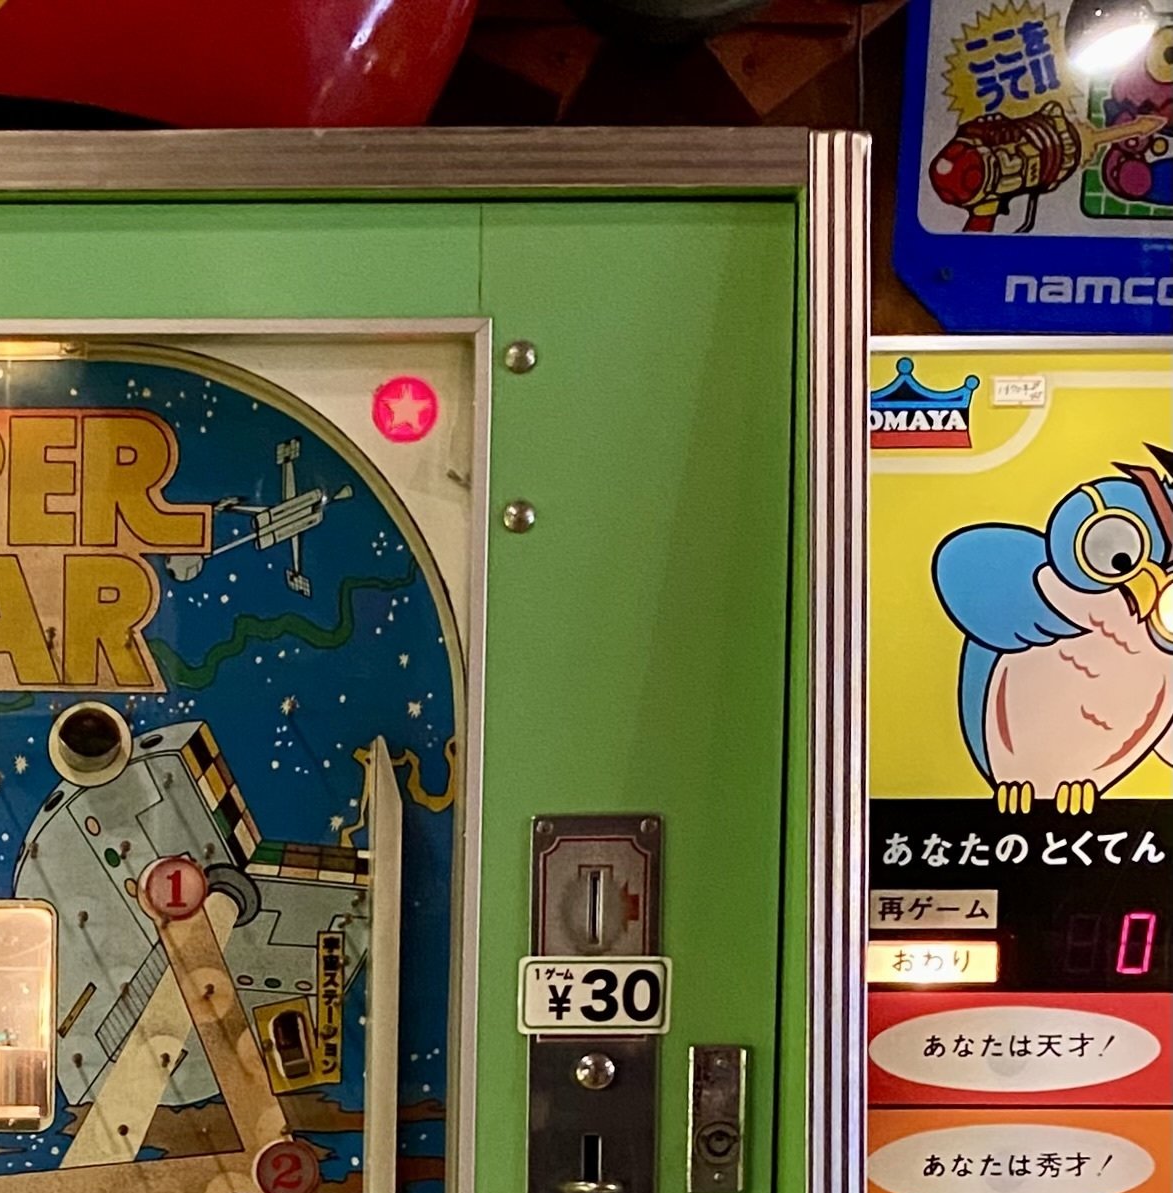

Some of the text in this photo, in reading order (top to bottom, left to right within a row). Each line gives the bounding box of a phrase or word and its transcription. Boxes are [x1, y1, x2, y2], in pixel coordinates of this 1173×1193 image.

[965, 21, 1050, 74] ここを
[166, 869, 187, 908] 1
[878, 895, 989, 922] 再ゲーム
[892, 949, 971, 973] おわり
[1116, 913, 1156, 974] 0
[548, 968, 661, 1022] ¥30
[271, 1154, 304, 1189] 2
